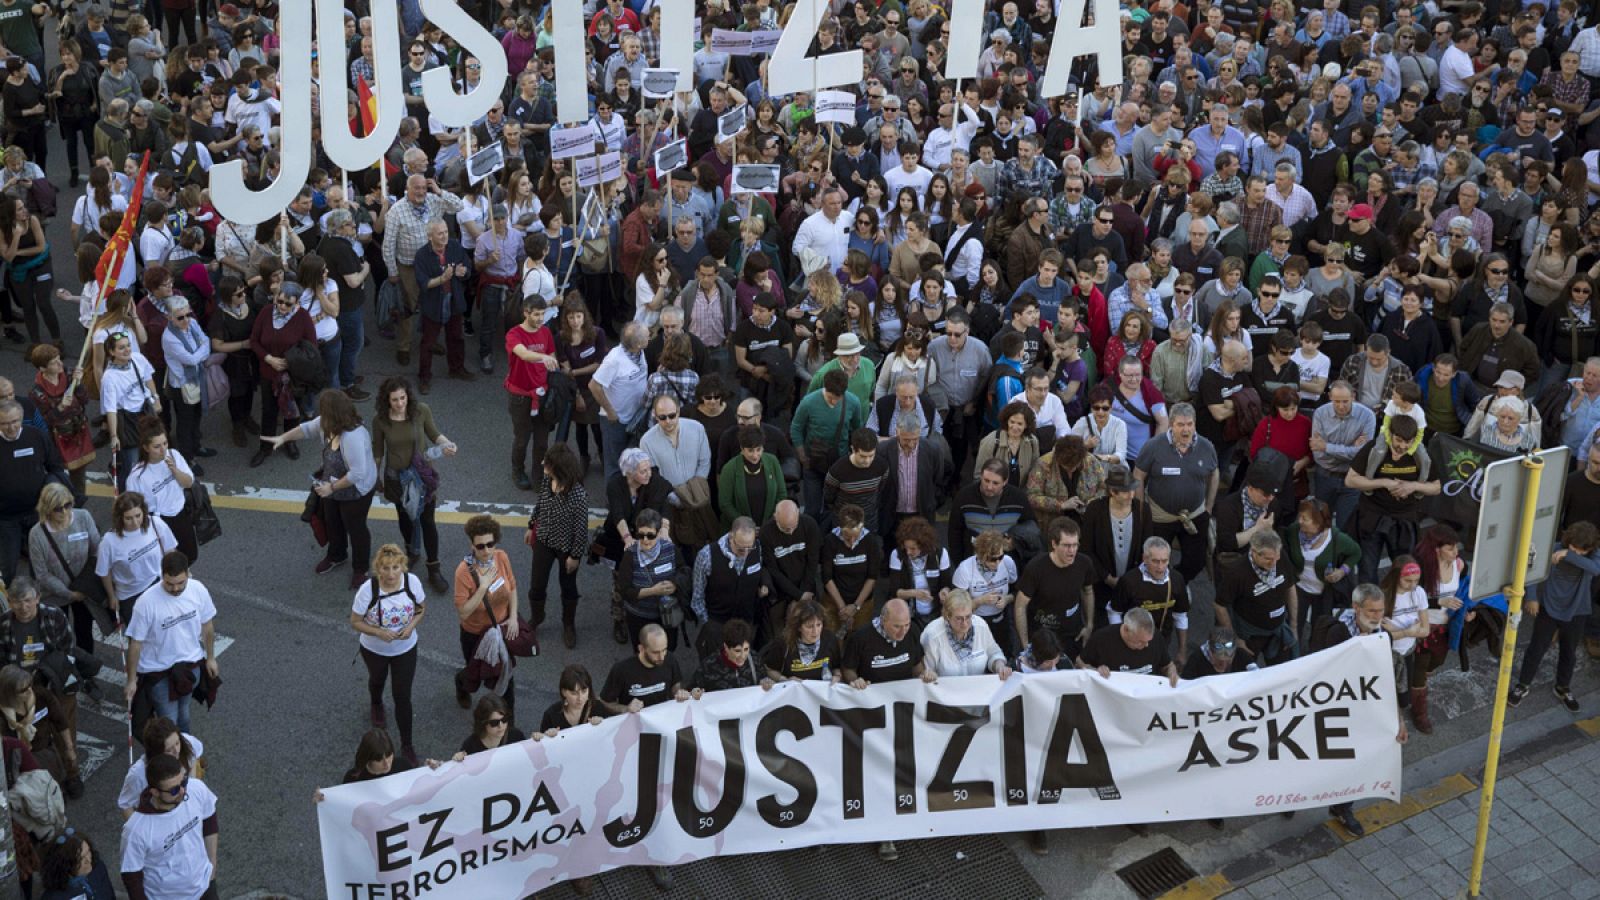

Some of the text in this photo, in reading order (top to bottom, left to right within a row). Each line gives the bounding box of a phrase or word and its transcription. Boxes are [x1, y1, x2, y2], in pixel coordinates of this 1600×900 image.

[1147, 676, 1382, 731] ALTSASUKOAK
[1177, 708, 1355, 772] ASKE
[603, 693, 1122, 848] JUSTIZIA
[899, 794, 913, 806] 50
[953, 789, 968, 801] 50
[1008, 789, 1024, 799] 50
[1041, 790, 1060, 799] 12.5
[846, 800, 860, 811] 50
[779, 811, 794, 821] 50
[376, 780, 561, 872] EZ DA
[699, 817, 714, 829] 50
[617, 826, 641, 842] 62.5
[345, 818, 586, 900] TERRORISMOA
